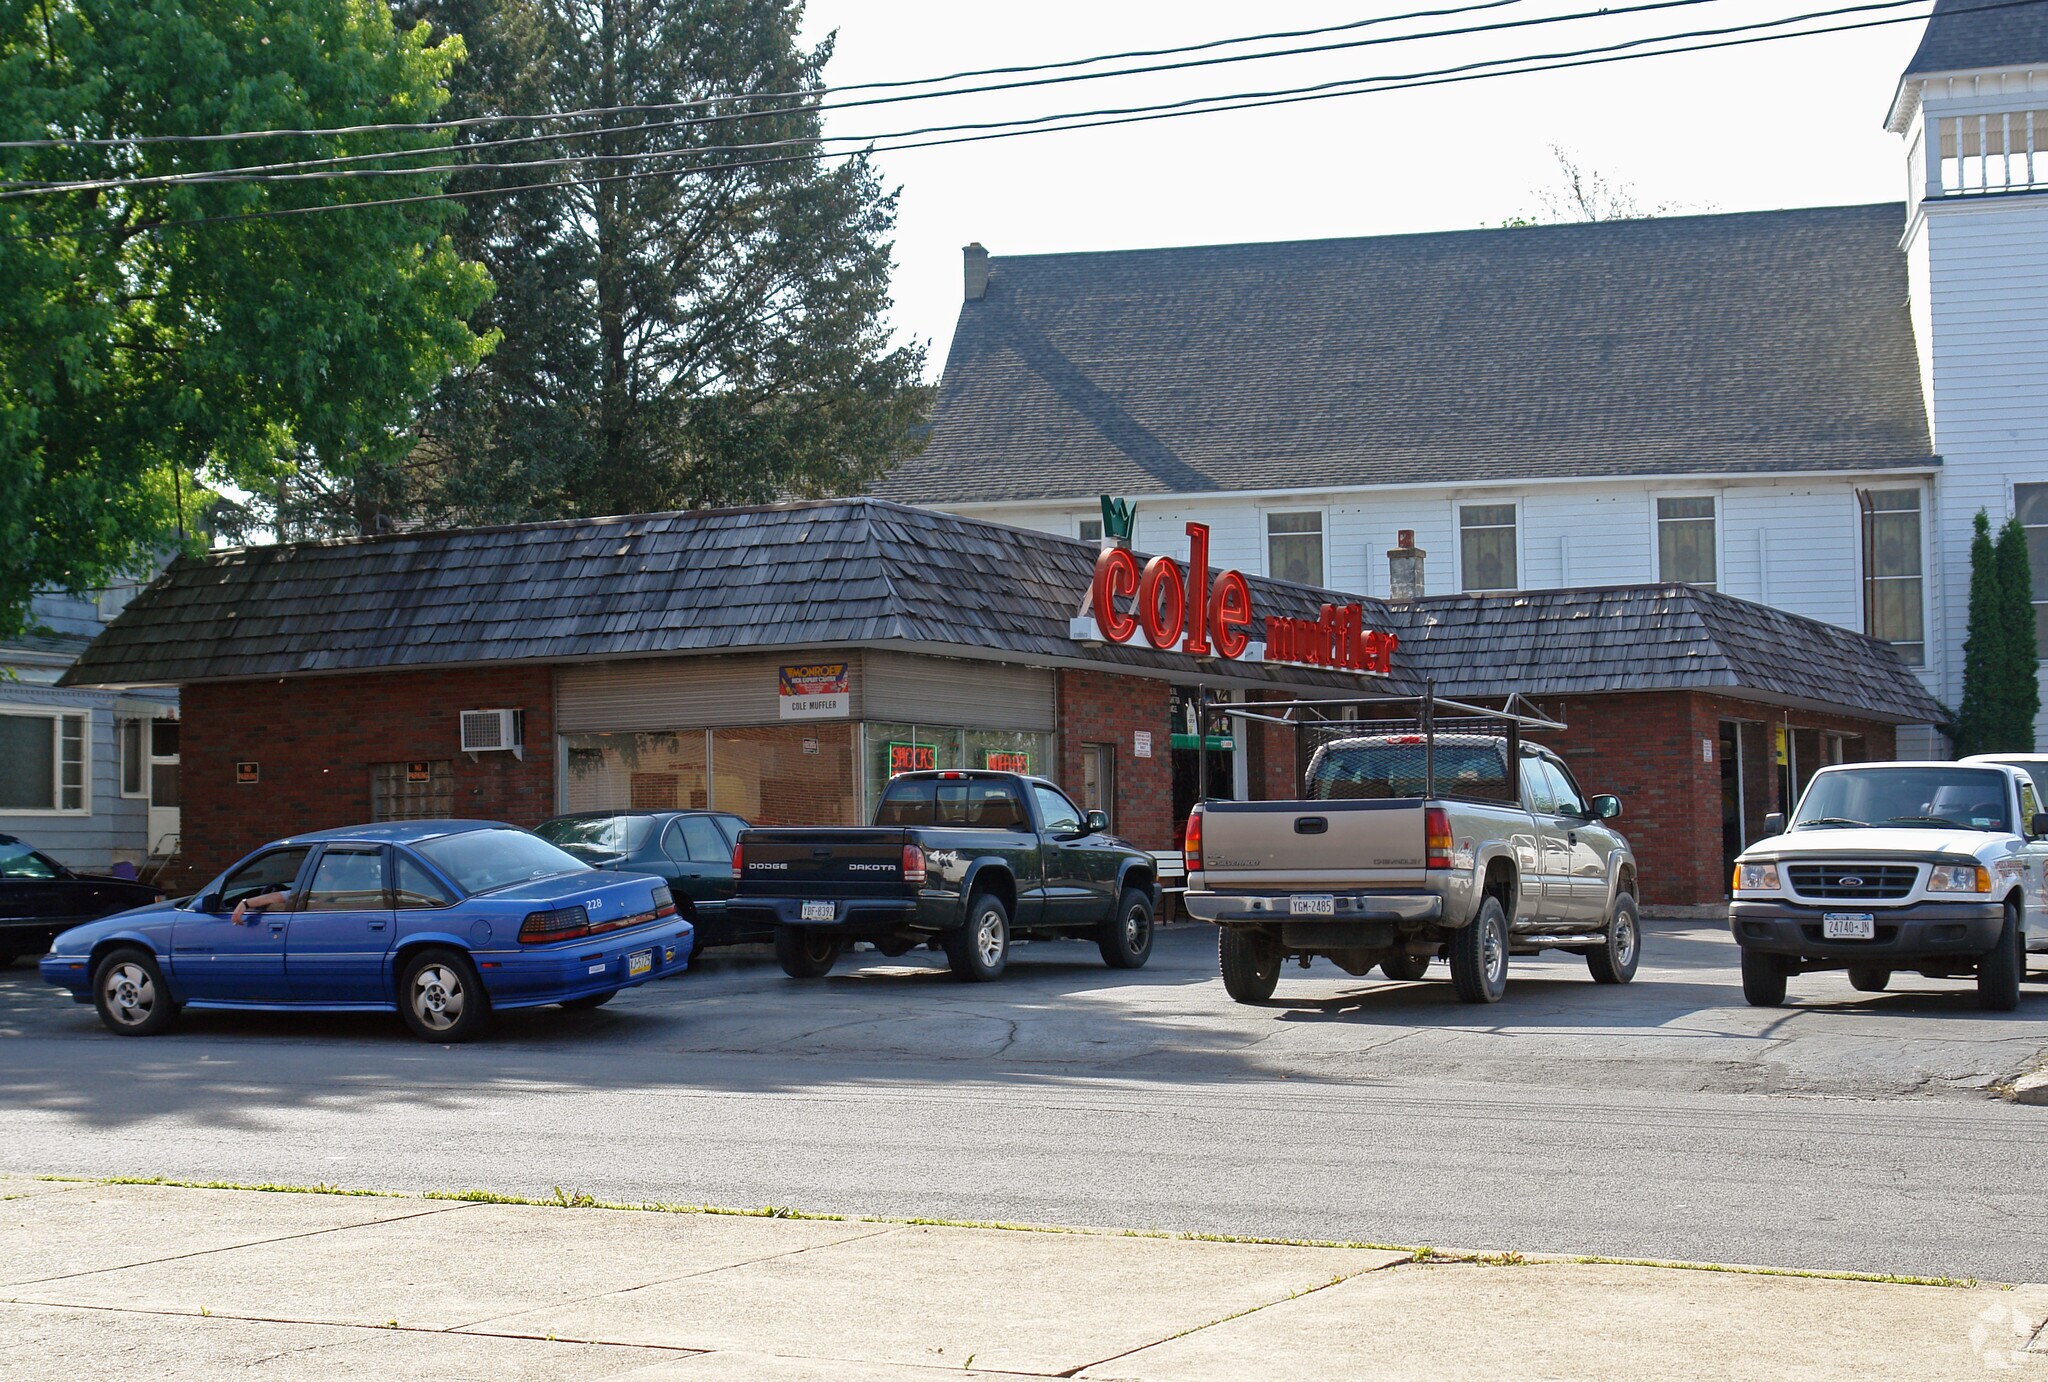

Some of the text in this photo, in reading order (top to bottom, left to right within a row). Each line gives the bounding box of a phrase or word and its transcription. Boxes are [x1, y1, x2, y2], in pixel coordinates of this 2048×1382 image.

[1092, 522, 1398, 674] cole muffler
[792, 665, 836, 677] MONROE
[792, 700, 837, 711] COLE MUFFLER
[891, 747, 935, 770] SHOCKS
[930, 850, 958, 862] 4x4
[849, 863, 896, 871] DAKOTA
[586, 899, 603, 910] 228
[1293, 900, 1331, 912] YGM-2485
